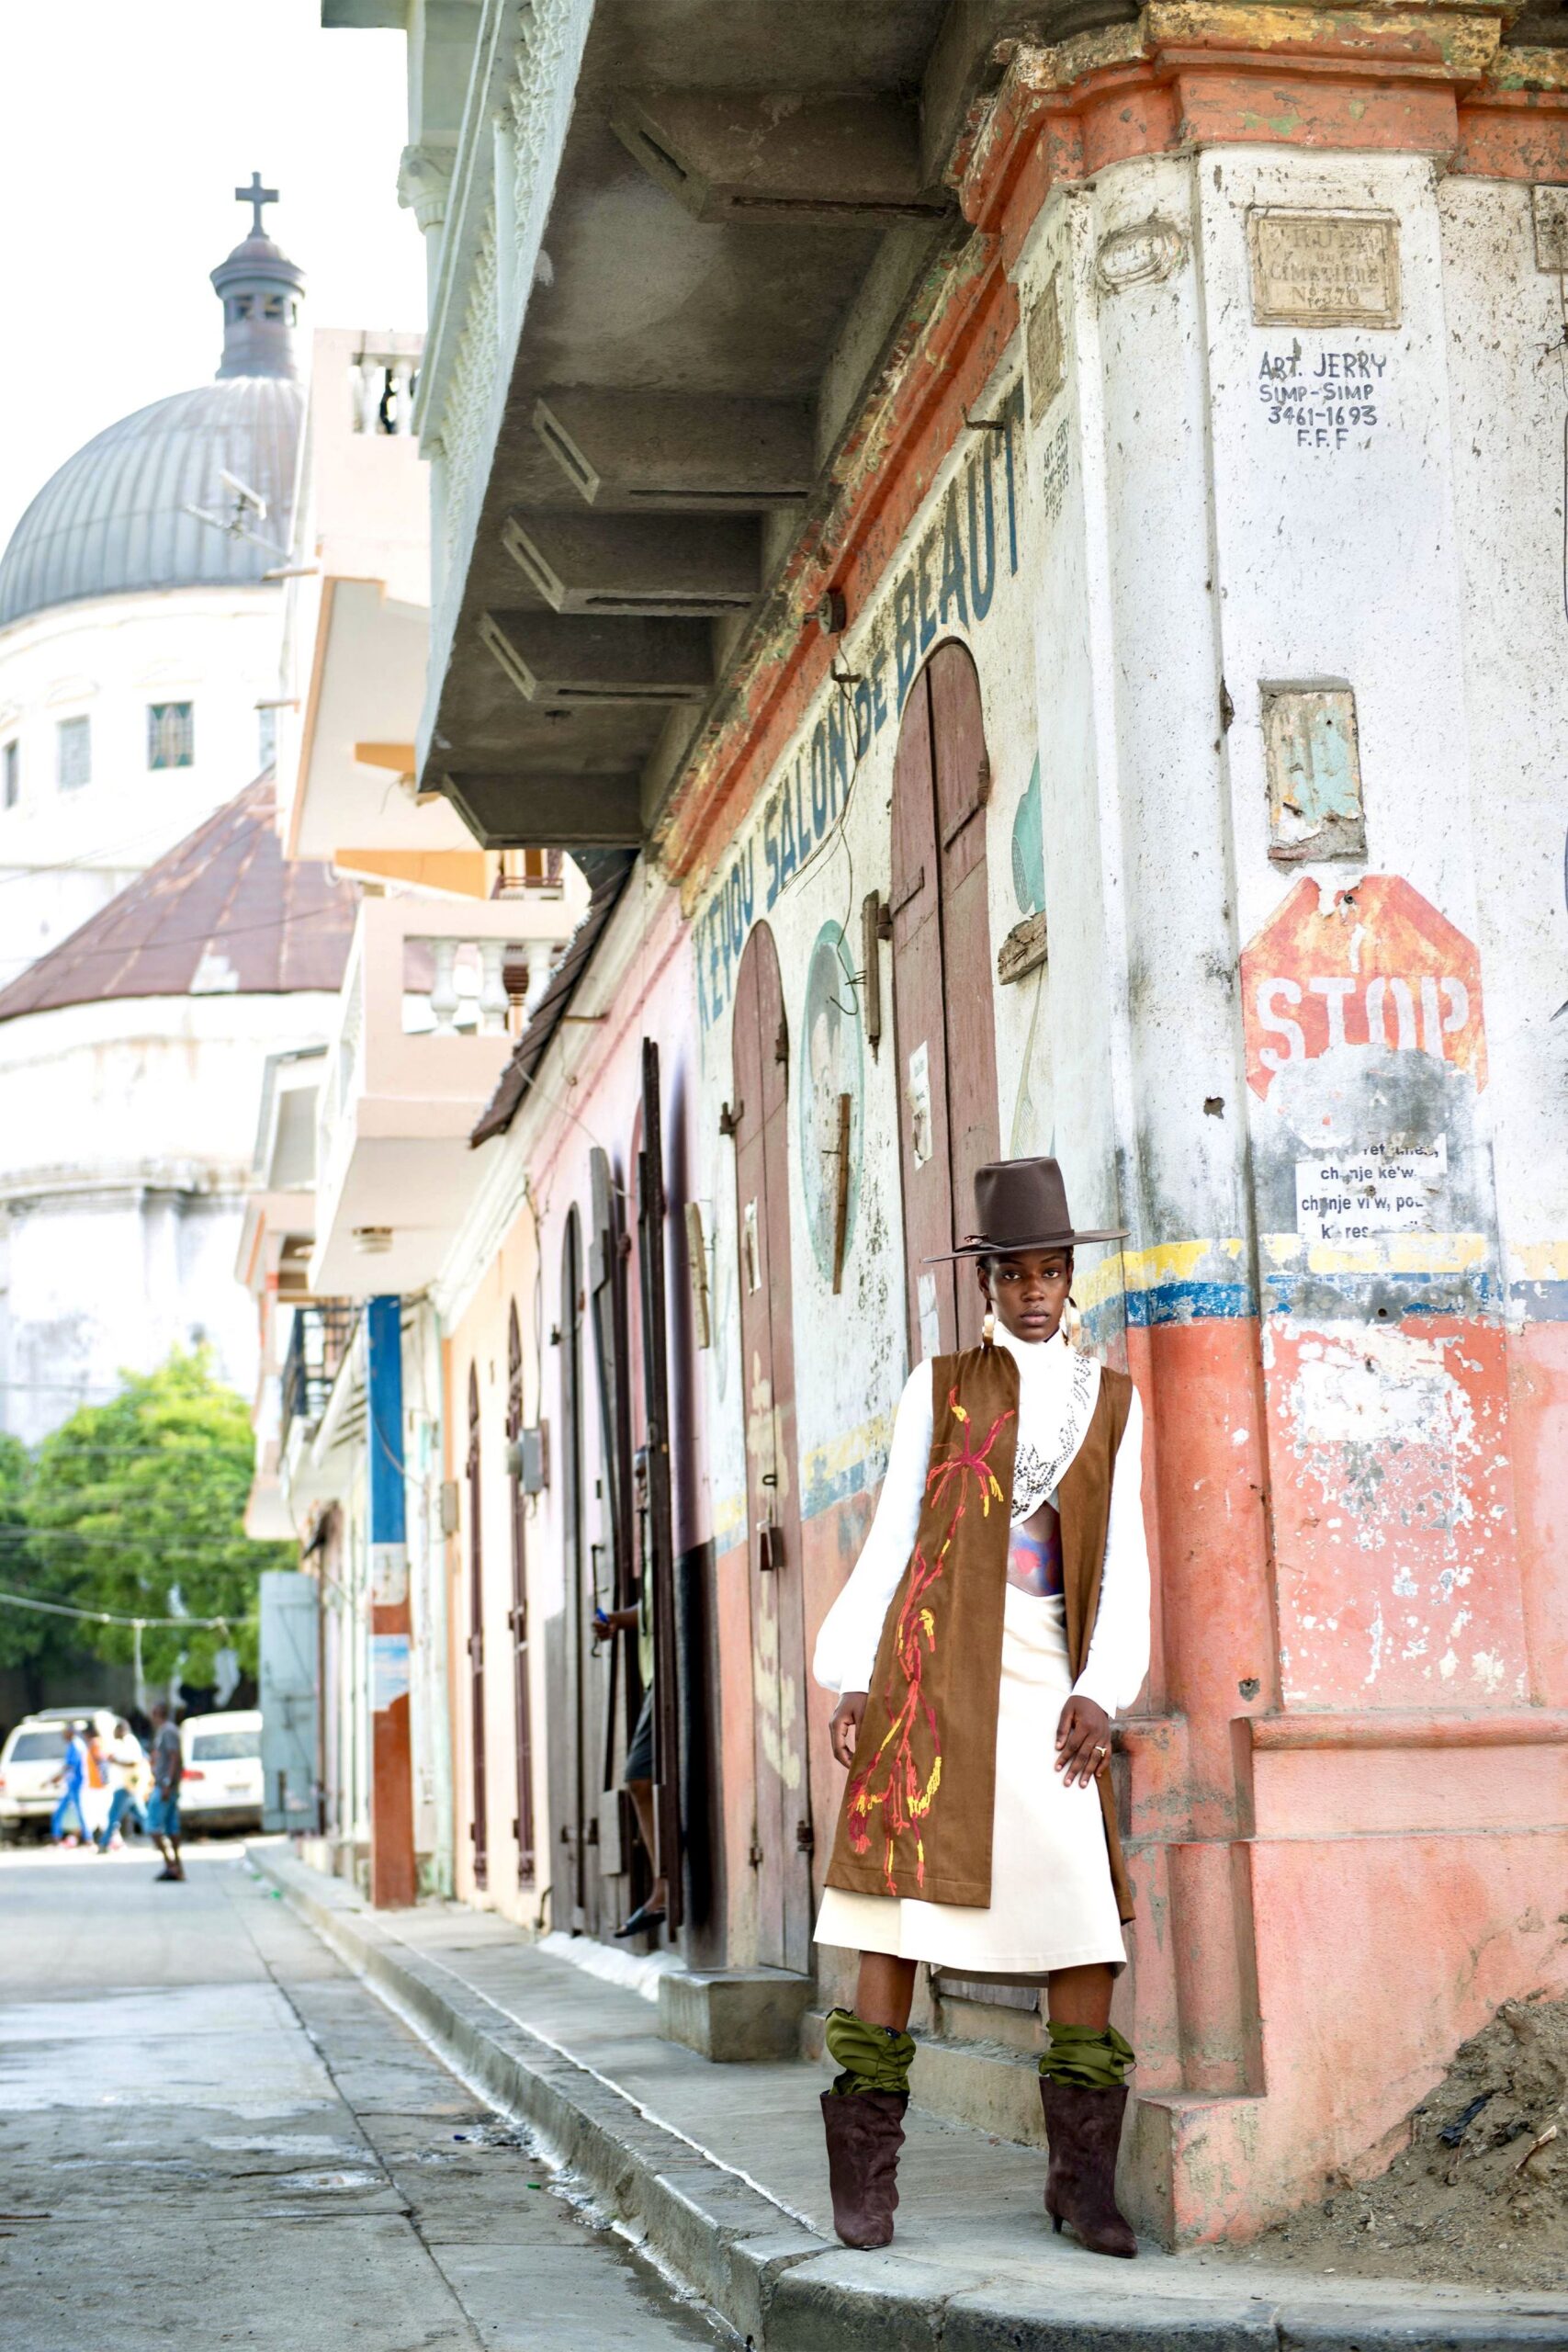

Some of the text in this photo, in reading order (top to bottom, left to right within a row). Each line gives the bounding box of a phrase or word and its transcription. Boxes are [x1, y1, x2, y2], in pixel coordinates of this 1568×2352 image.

[1292, 228, 1356, 249] RUE
[1313, 352, 1388, 379] JERRY
[1268, 404, 1379, 426] 3461-1693
[764, 691, 850, 912] SALON
[854, 650, 887, 761] DE
[1256, 977, 1471, 1072] STOP
[1320, 1166, 1373, 1182] chnje
[1302, 1194, 1351, 1215] chnje
